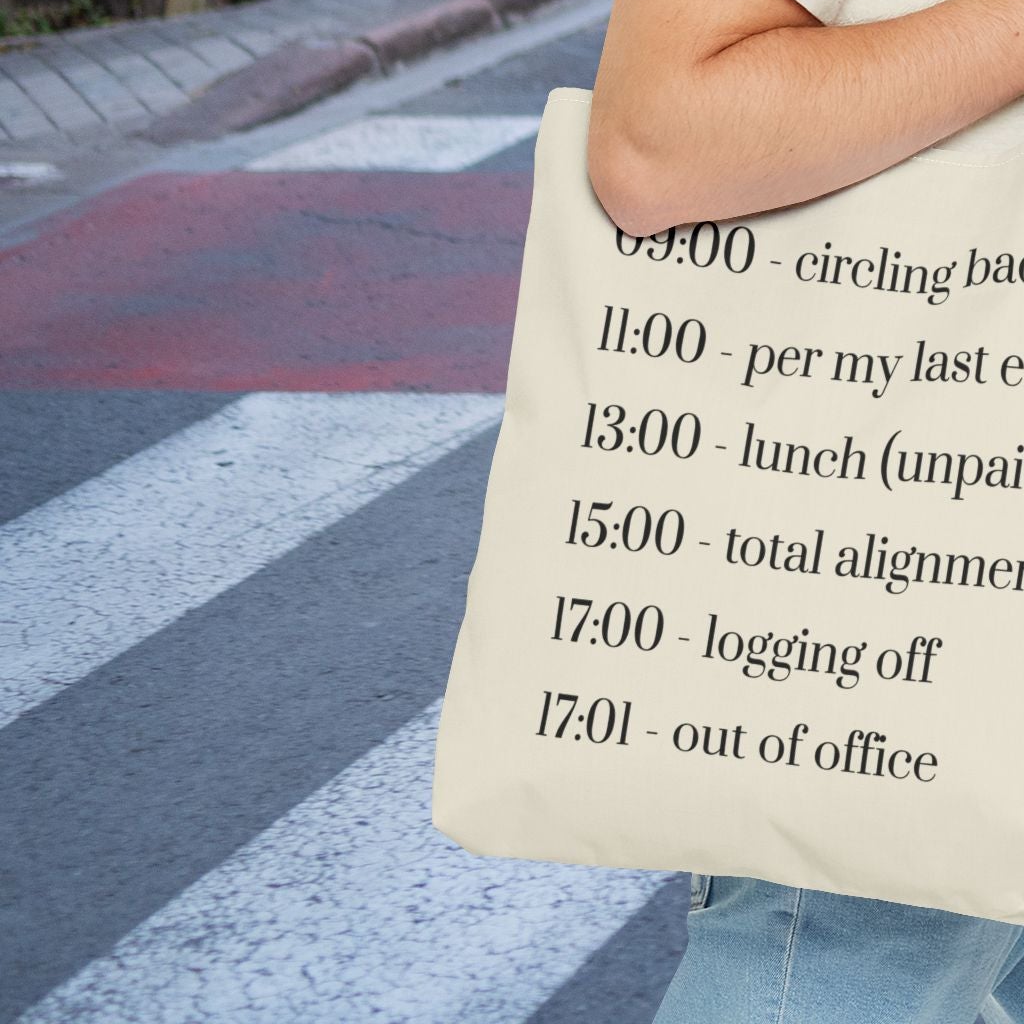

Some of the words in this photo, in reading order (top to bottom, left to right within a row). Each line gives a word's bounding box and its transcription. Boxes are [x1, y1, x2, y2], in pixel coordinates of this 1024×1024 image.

[795, 241, 957, 306] circling
[597, 305, 707, 364] 11:00
[741, 343, 824, 388] per
[831, 351, 903, 399] my
[910, 340, 990, 384] last
[581, 402, 702, 459] 13:00
[738, 422, 867, 480] lunch
[565, 499, 685, 556] 15:00
[725, 528, 825, 575] total
[551, 595, 665, 652] 17:00
[702, 613, 868, 690] logging
[876, 635, 943, 684] off
[535, 690, 632, 746] 17:01
[672, 723, 747, 760] out
[758, 723, 809, 767] of
[814, 729, 939, 783] office
